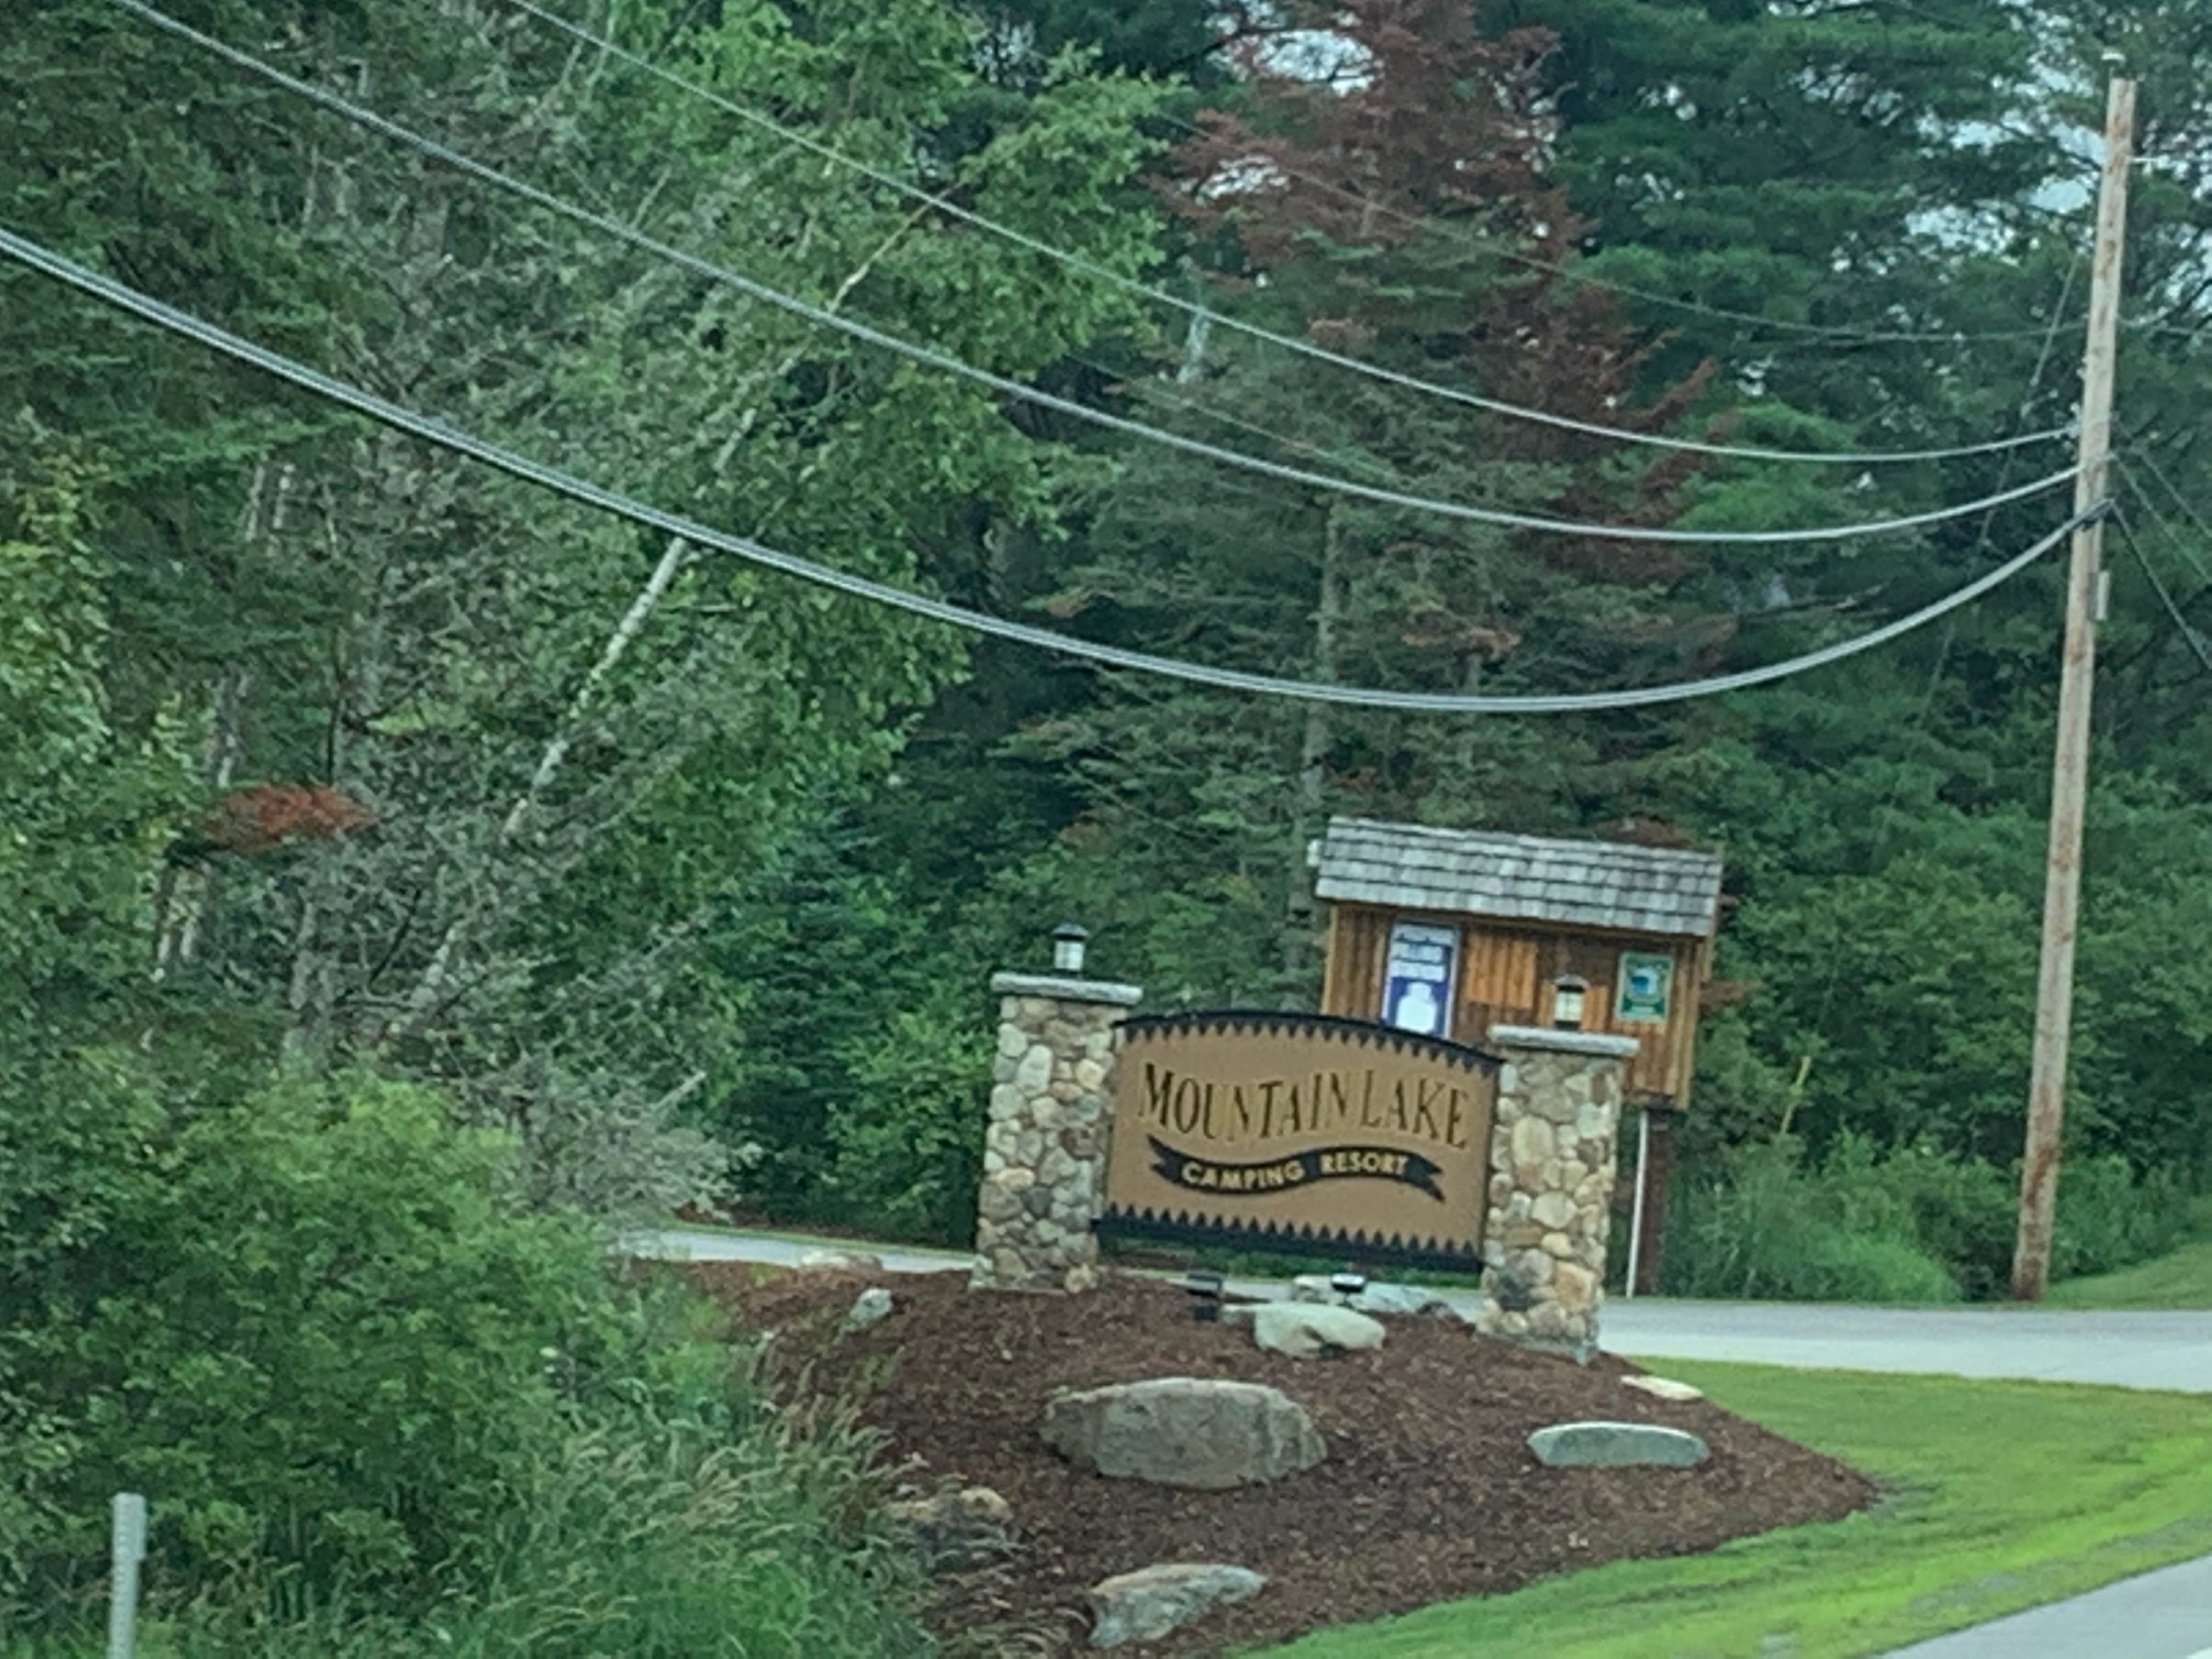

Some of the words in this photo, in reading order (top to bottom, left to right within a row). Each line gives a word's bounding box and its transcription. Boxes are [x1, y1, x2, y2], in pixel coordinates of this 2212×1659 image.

[1138, 1062, 1348, 1142] MOUNTAIN
[1360, 1069, 1467, 1149] LAKE
[1182, 1159, 1305, 1189] CAMPING
[1321, 1152, 1410, 1176] RESORT
